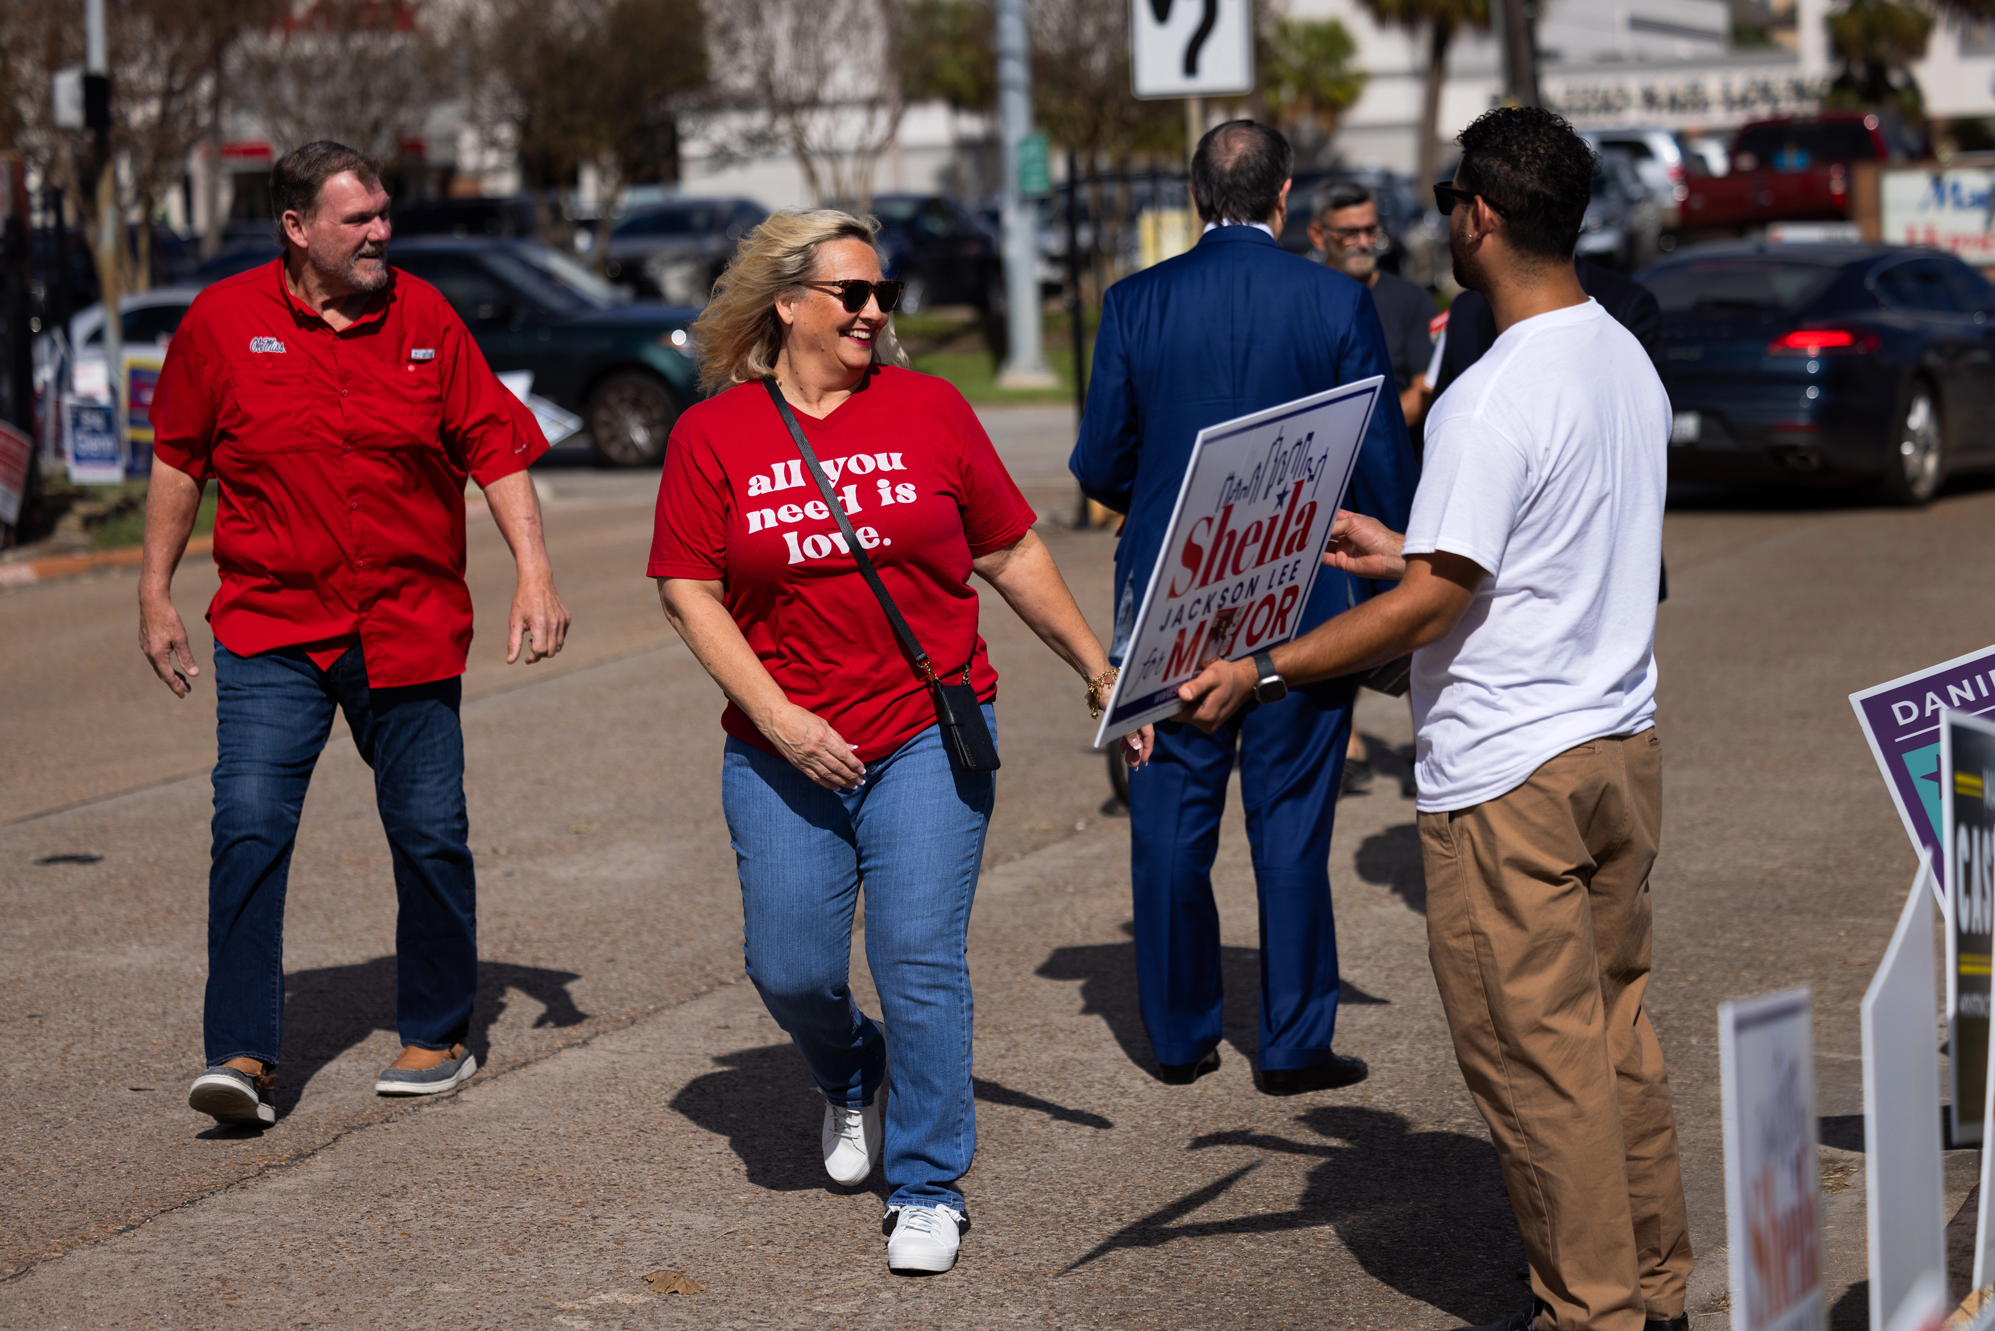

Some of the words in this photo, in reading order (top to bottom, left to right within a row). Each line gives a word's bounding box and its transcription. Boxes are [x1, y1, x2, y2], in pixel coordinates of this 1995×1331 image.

[746, 484, 863, 534] need
[876, 478, 918, 507] is
[747, 459, 806, 497] all
[819, 452, 908, 489] you
[782, 526, 892, 565] love.
[1166, 478, 1319, 602] Sheila
[1159, 575, 1261, 633] JACKSON
[1266, 559, 1302, 591] LEE
[1161, 584, 1300, 683] MYOR
